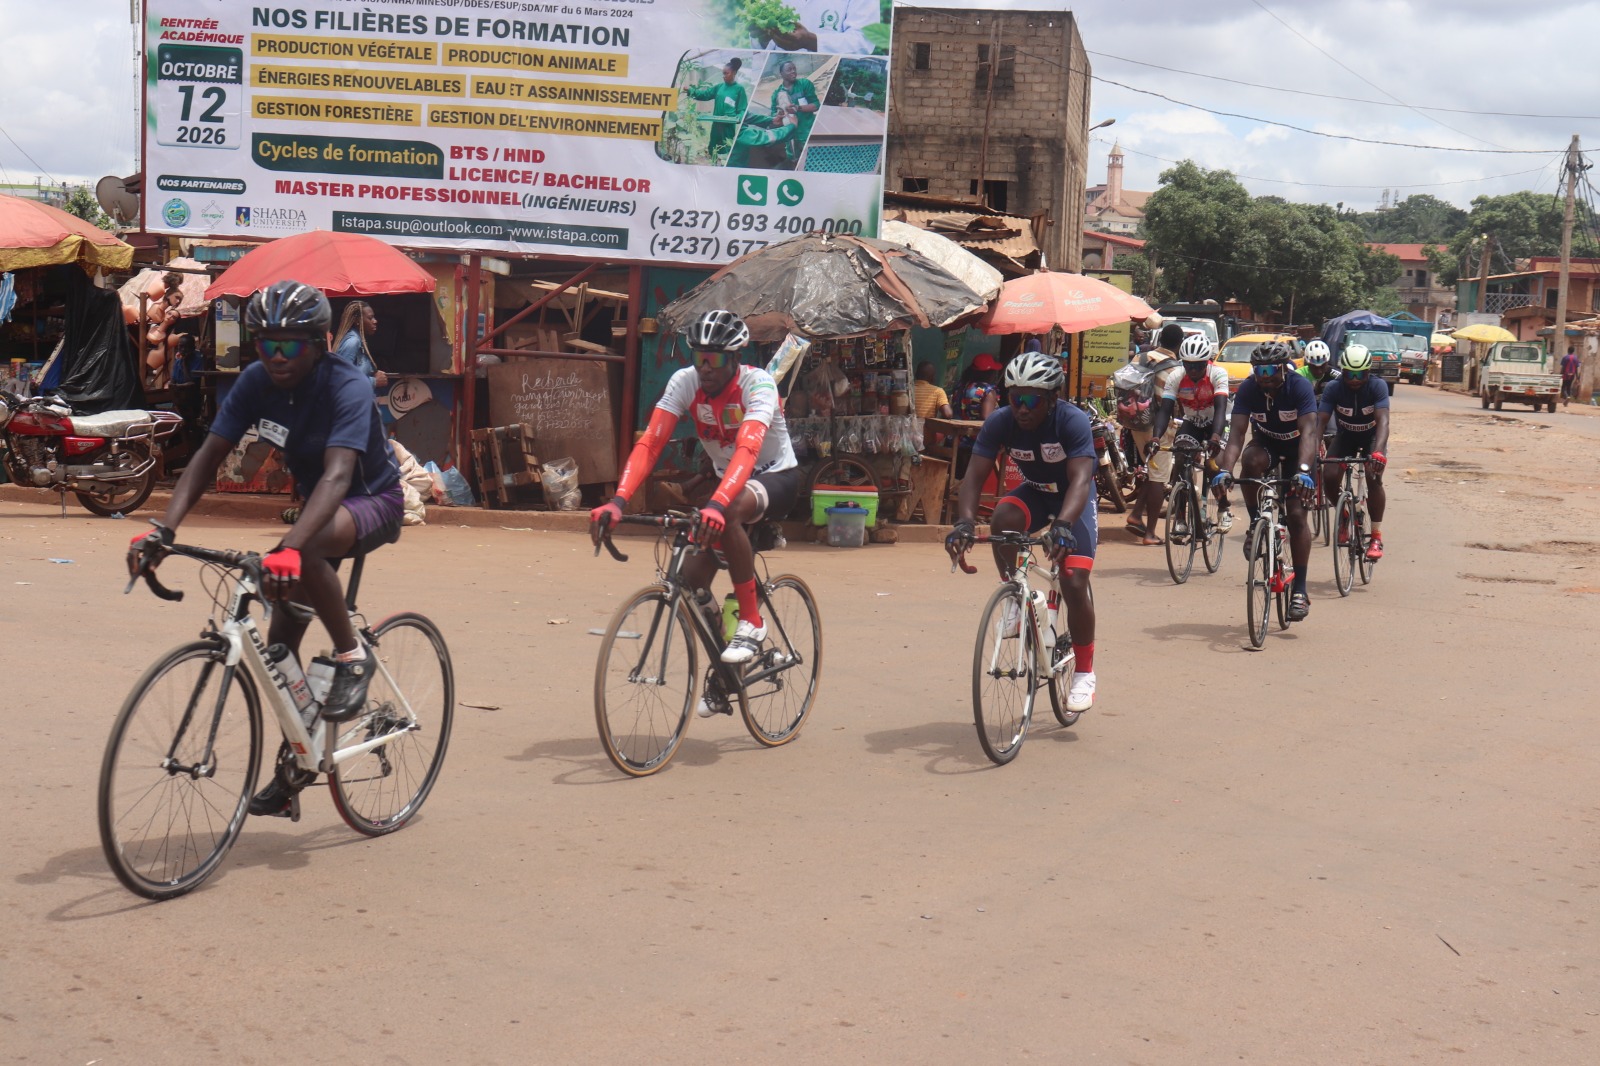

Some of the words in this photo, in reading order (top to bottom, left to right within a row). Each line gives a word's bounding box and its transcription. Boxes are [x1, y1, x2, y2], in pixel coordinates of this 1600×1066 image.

[584, 8, 608, 17] Mars
[610, 9, 633, 18] 2024
[160, 18, 219, 30] RENTRÉE
[253, 8, 307, 29] NOS
[315, 8, 428, 35] FILIÈRES
[435, 16, 469, 36] DE
[477, 18, 630, 47] FORMATION
[160, 30, 244, 44] ACADÉMIQUE
[257, 39, 353, 57] PRODUCTION
[357, 41, 432, 60] VÉGÉTALE
[161, 62, 238, 79] OCTOBRE
[448, 49, 545, 67] PRODUCTION
[548, 54, 616, 72] ANIMALE
[258, 68, 330, 87] ÉNERGIES
[333, 74, 461, 93] RENOUVELABLES
[476, 80, 506, 95] EAU
[509, 82, 524, 97] ET
[528, 84, 671, 106] ASSAINNISSEMENT
[177, 85, 228, 123] 12
[256, 101, 321, 117] GESTION
[325, 103, 413, 122] FORESTIÈRE
[430, 109, 495, 126] GESTION
[176, 126, 226, 145] 2026
[258, 140, 318, 162] Cycles
[322, 143, 342, 160] de
[348, 144, 438, 166] formation
[450, 146, 489, 161] BTS
[504, 149, 545, 164] HND
[160, 178, 179, 187] NOS
[181, 180, 244, 191] PARTENAIRES
[275, 180, 354, 198] MASTER
[543, 172, 650, 194] BACHELOR
[253, 208, 306, 221] SHARDA
[253, 218, 308, 227] UNIVERSITY
[650, 207, 721, 233] (+237)
[727, 213, 768, 232] 693
[774, 216, 815, 234] 400
[822, 218, 863, 236] 000
[341, 215, 503, 235] istapa.sup@outlook.com
[650, 233, 721, 260] (+237)
